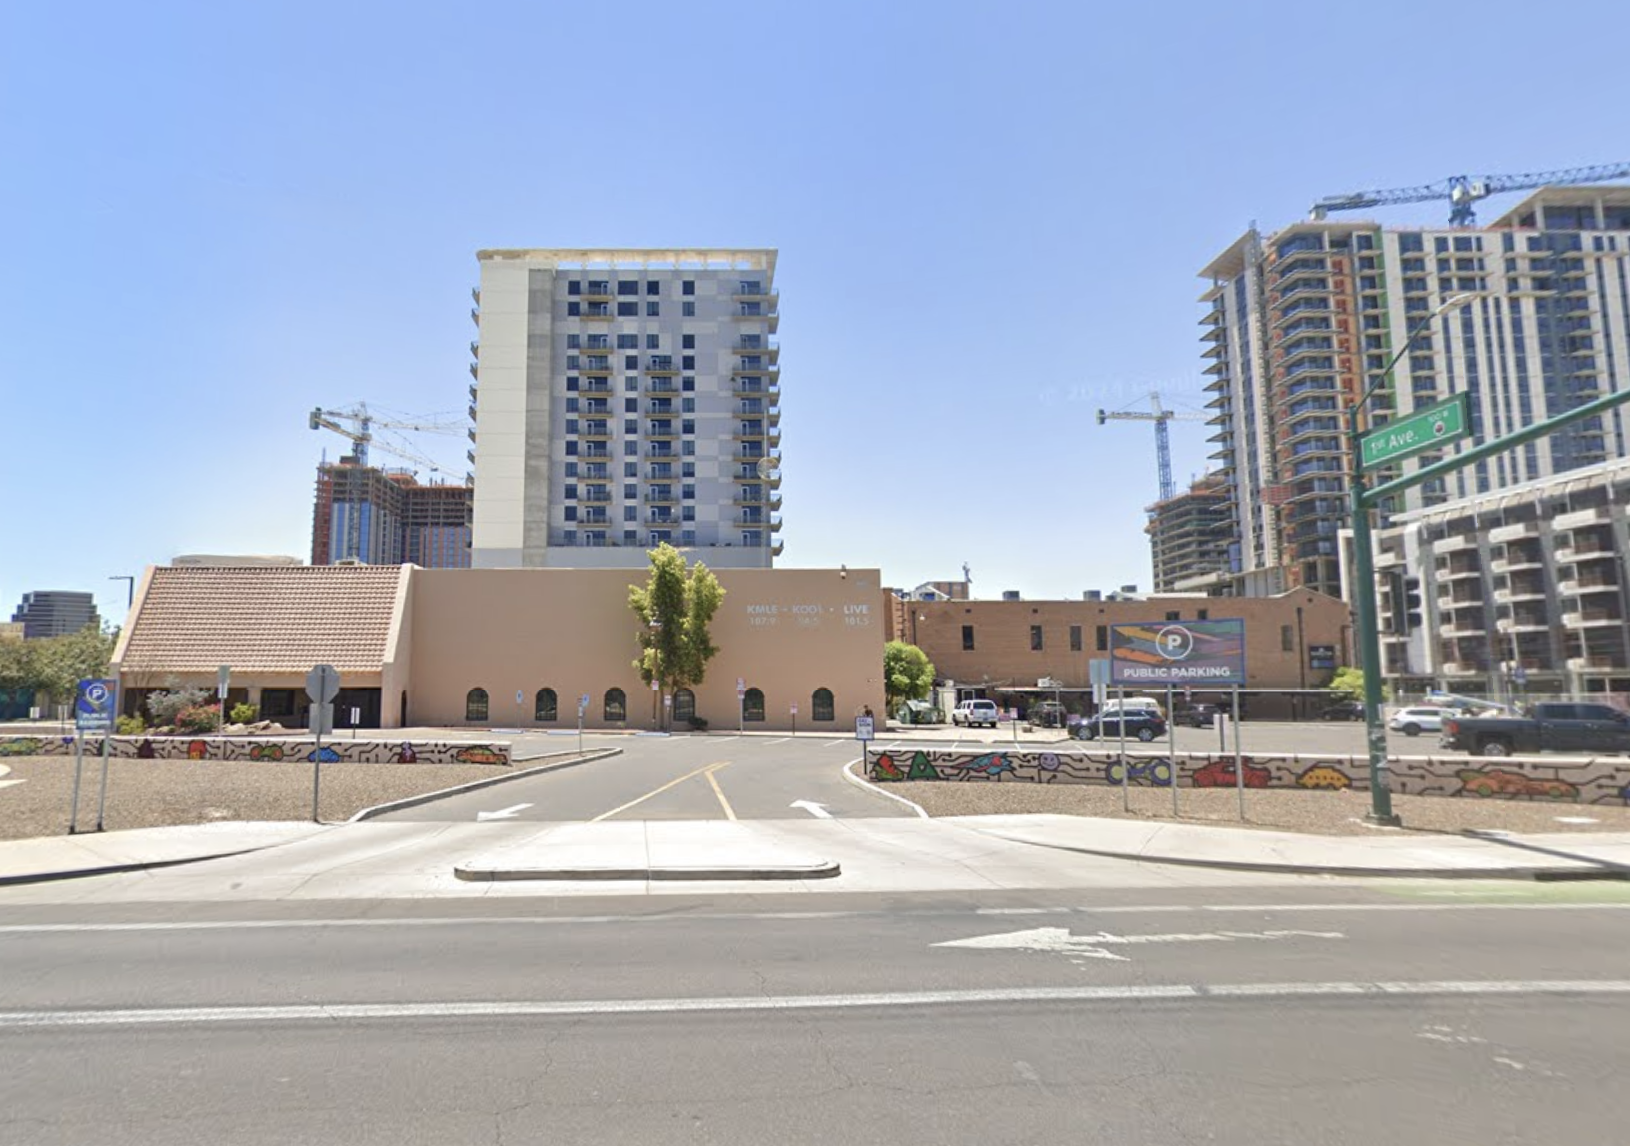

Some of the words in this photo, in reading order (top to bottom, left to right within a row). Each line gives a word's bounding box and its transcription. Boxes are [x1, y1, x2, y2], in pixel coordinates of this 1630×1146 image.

[1371, 439, 1385, 455] 1st
[1389, 431, 1418, 448] Ave.
[746, 604, 778, 614] KMLE
[843, 604, 869, 614] LIVE
[1168, 635, 1182, 650] P
[1123, 667, 1168, 678] PUBLIC
[1172, 667, 1230, 677] PARKING
[92, 690, 102, 699] P
